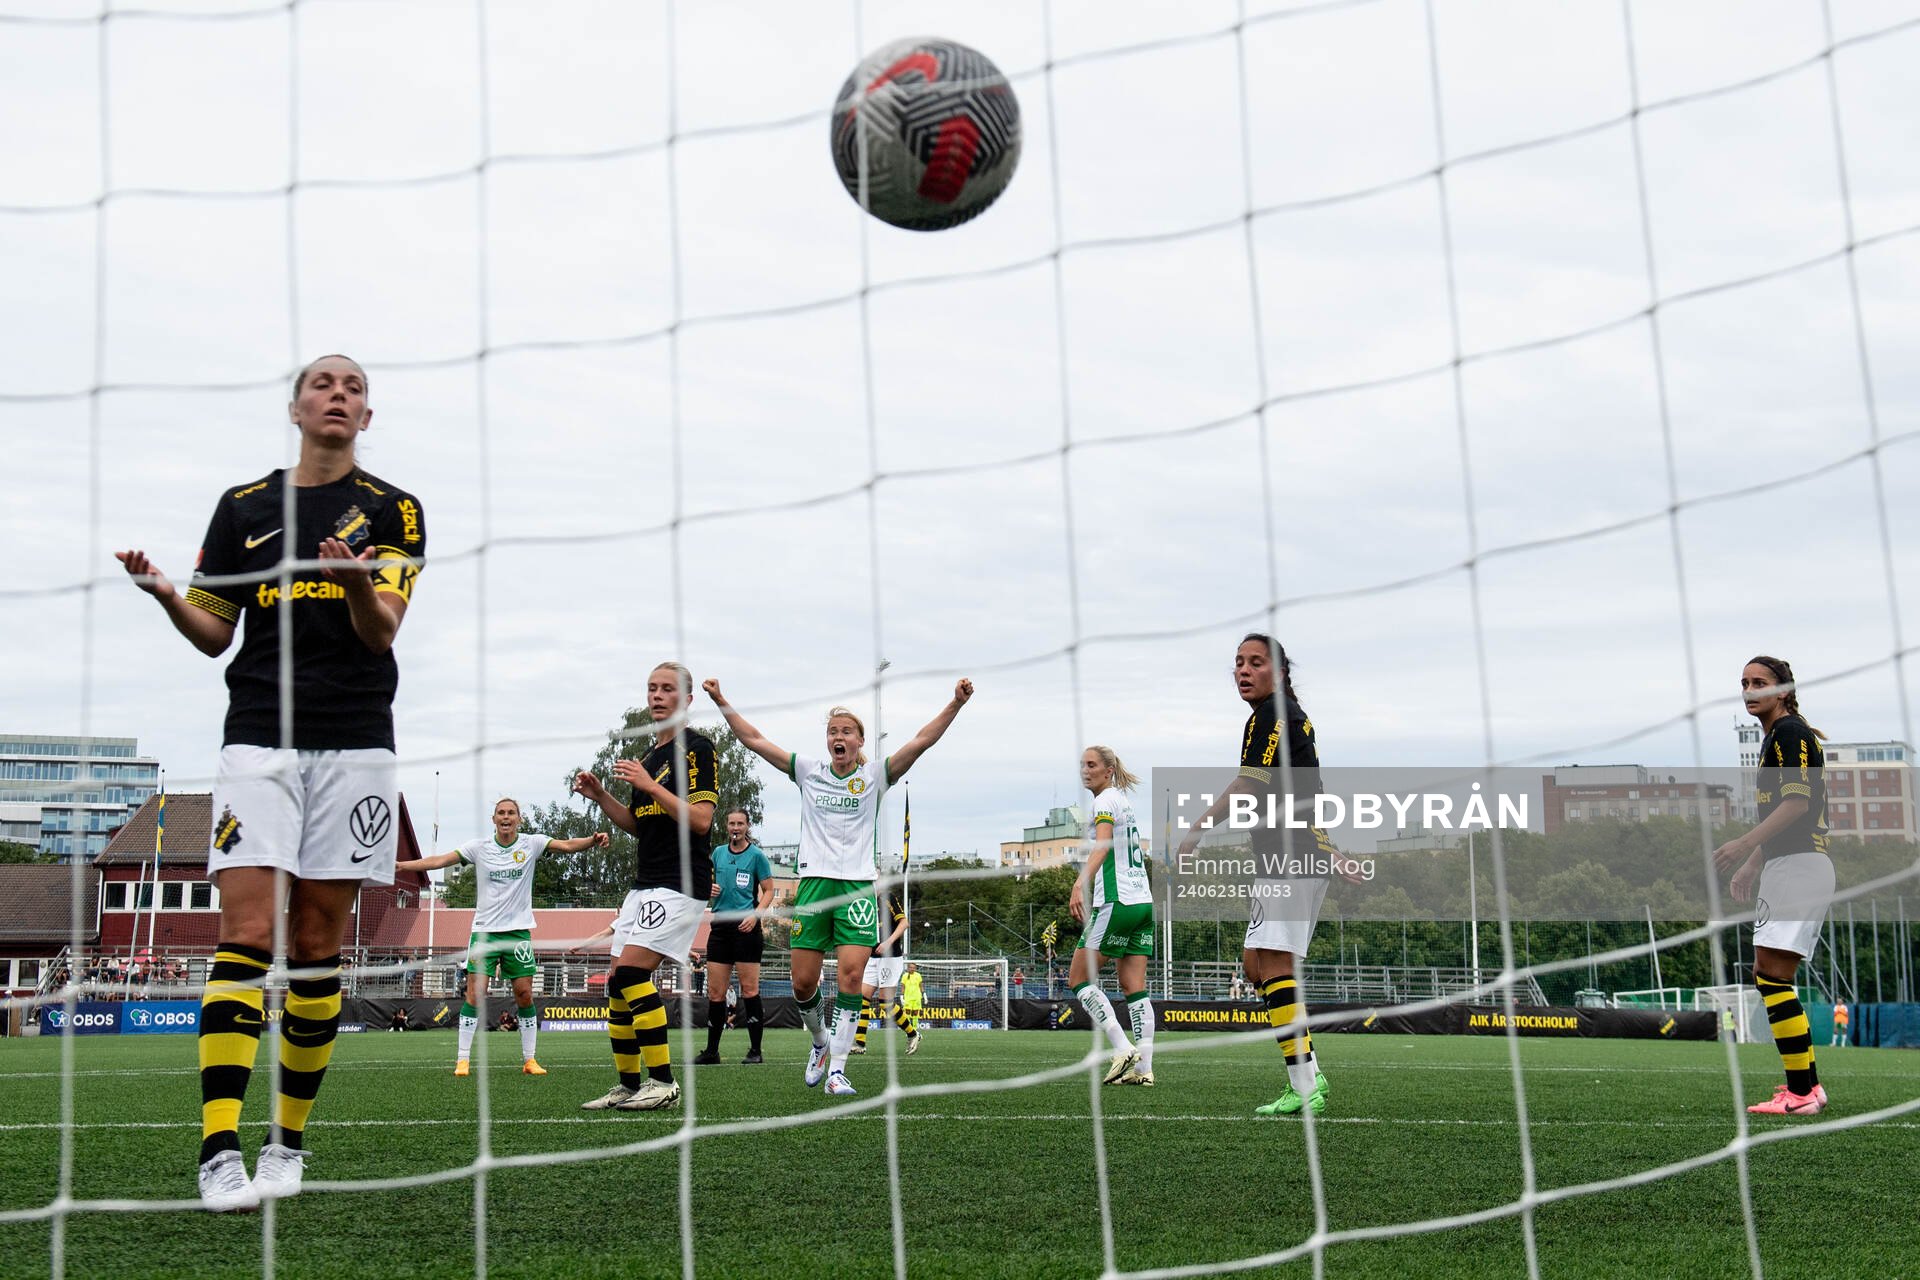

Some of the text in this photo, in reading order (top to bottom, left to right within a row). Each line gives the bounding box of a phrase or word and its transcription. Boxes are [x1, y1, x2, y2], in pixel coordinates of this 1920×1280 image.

[1262, 718, 1286, 766] stadium
[815, 795, 859, 808] PROJOB
[489, 869, 523, 879] PROJOB
[73, 1013, 114, 1026] OBOS
[154, 1013, 196, 1026] OBOS
[544, 1007, 610, 1019] STOCKHOLM
[1164, 1010, 1230, 1022] STOCKHOLM
[1232, 1009, 1247, 1023] ÄR
[1469, 1012, 1578, 1029] AIK ÄR STOCKHOLM!
